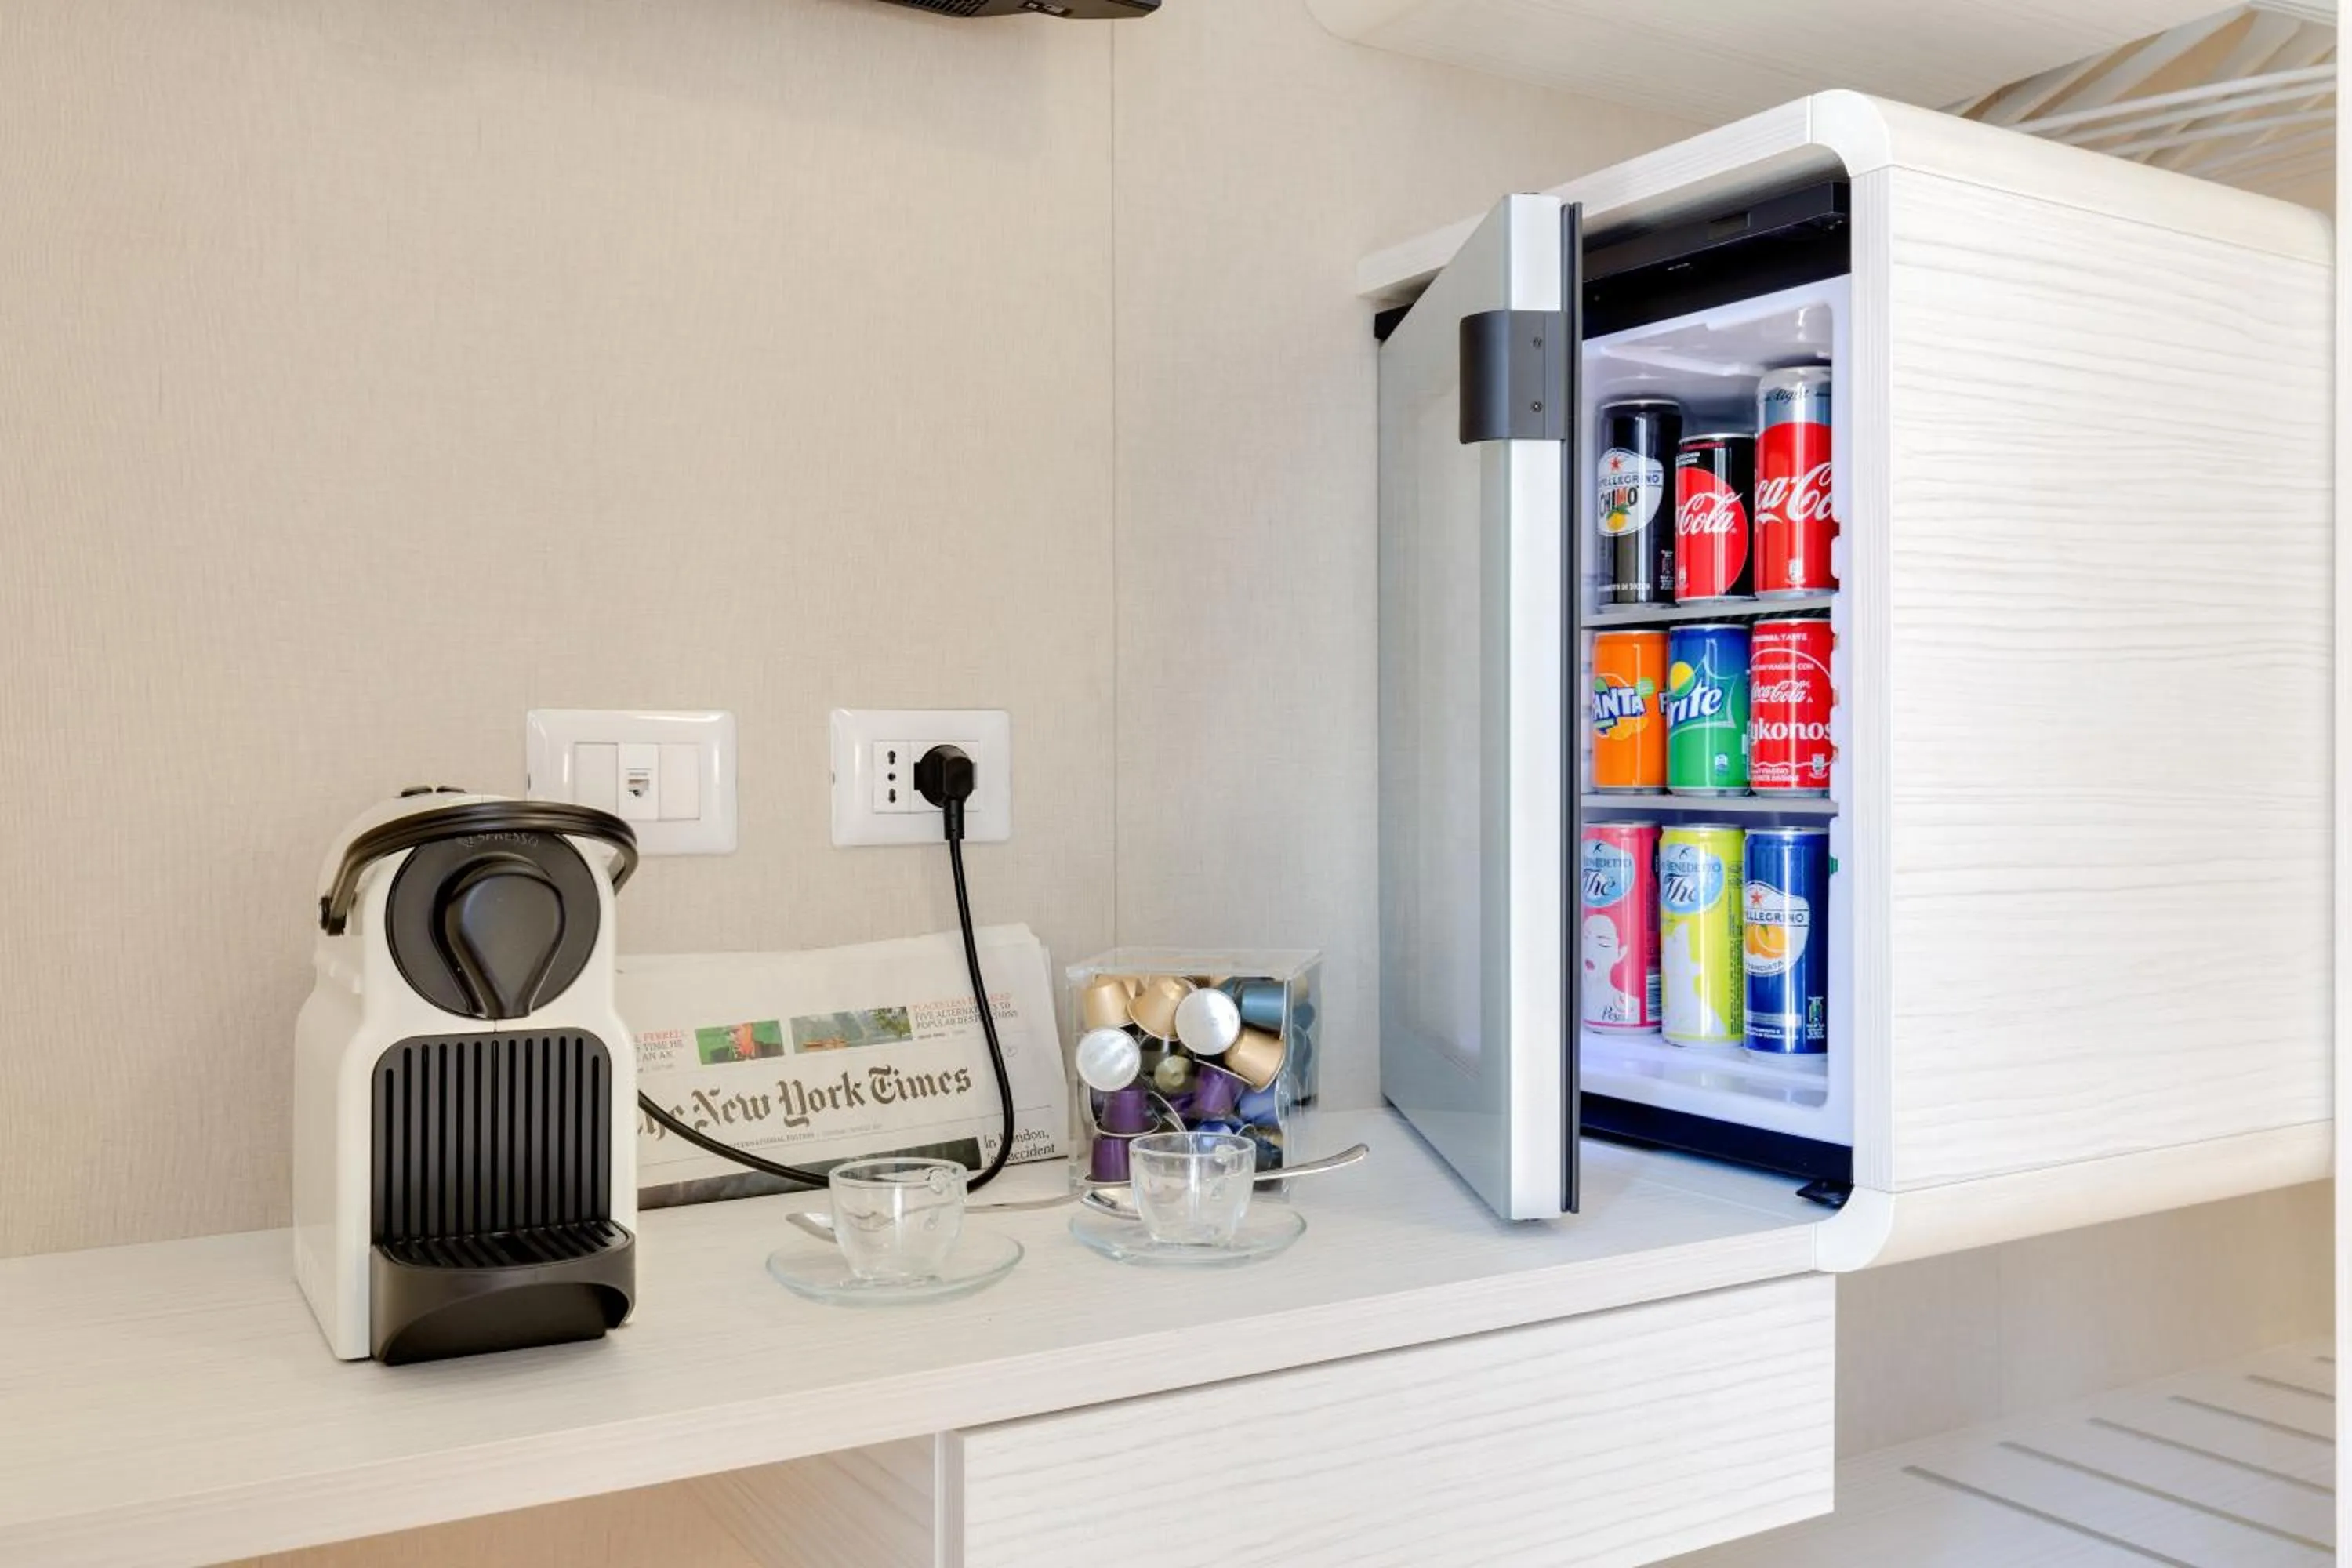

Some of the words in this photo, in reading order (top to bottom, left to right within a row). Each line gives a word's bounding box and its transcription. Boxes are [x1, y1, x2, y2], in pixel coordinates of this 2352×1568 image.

[1592, 687, 1646, 721] ANTA
[1669, 677, 1722, 728] rite
[1750, 717, 1831, 746] ykonos
[691, 1087, 771, 1131] New
[775, 1071, 866, 1128] York
[867, 1063, 972, 1105] Times
[984, 1134, 996, 1149] In
[998, 1128, 1050, 1143] Lndon,
